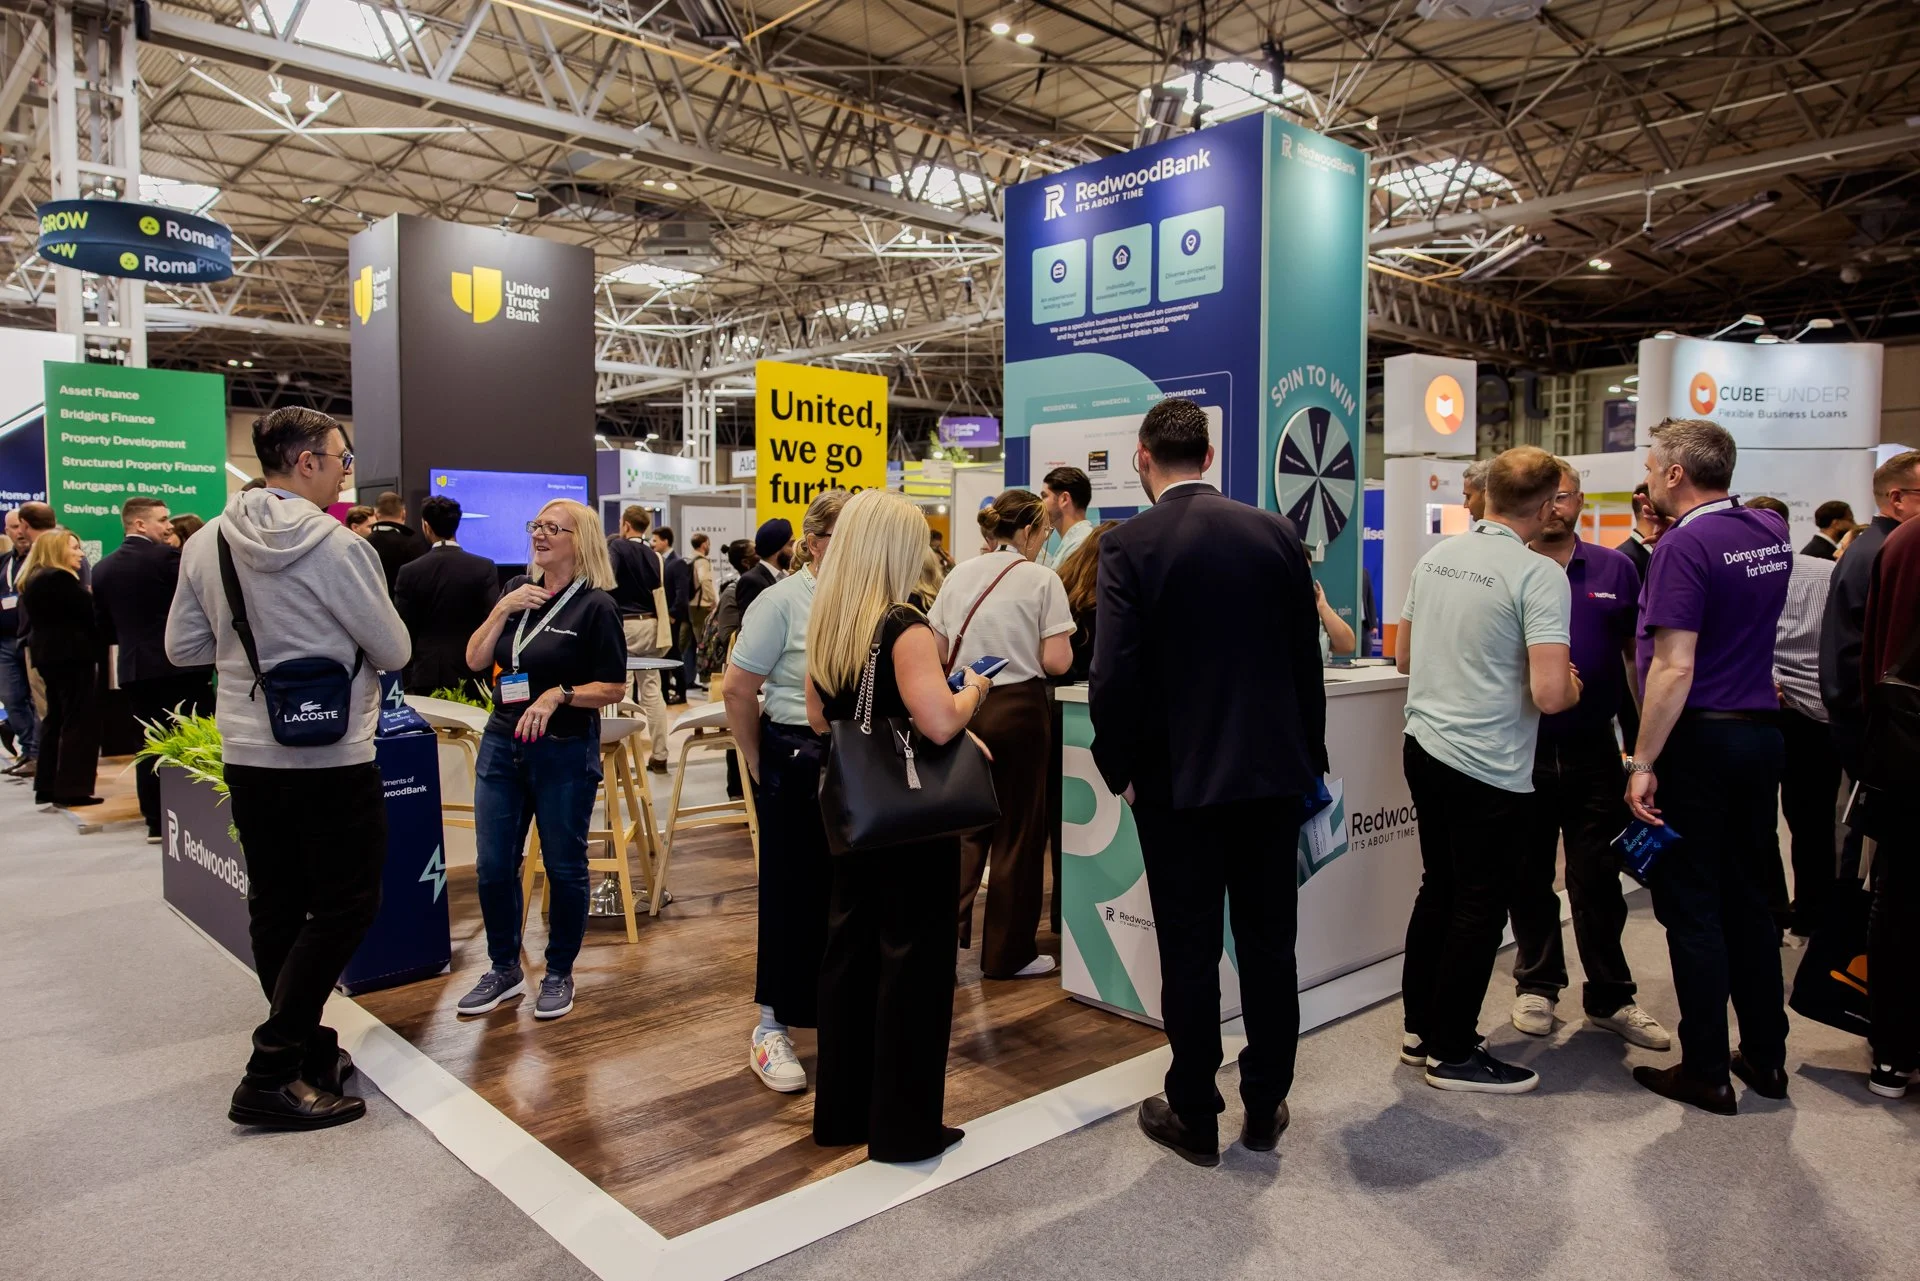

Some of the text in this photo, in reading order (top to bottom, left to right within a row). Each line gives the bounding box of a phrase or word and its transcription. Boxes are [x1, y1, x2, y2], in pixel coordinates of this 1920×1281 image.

[1297, 142, 1356, 176] RedwoodBank
[1075, 148, 1211, 202] RedwoodBank
[1075, 187, 1144, 213] IT'S ABOUT TIME
[41, 210, 88, 234] GROW
[505, 280, 550, 300] United
[505, 293, 540, 310] Trust
[506, 306, 540, 323] Bank
[1095, 317, 1118, 327] business
[1119, 314, 1132, 322] bank
[1133, 309, 1155, 320] focused
[1164, 301, 1199, 314] commercial
[1067, 331, 1077, 340] buy
[1092, 325, 1121, 337] mortgages
[1130, 317, 1164, 330] experienced
[1164, 312, 1190, 324] property
[1134, 328, 1152, 337] British
[59, 385, 140, 400] Asset Finance
[1092, 397, 1131, 408] COMMERCIAL
[1146, 387, 1207, 401] SEMI-COMMERCIAL
[1271, 365, 1356, 417] SPIN TO WIN
[1719, 386, 1850, 402] CUBEFUNDER
[60, 409, 155, 425] Bridging Finance
[770, 388, 882, 437] United,
[1718, 408, 1848, 419] Flexible Business Loans
[61, 433, 186, 449] Property Development
[62, 457, 217, 473] Structured Property Finance
[769, 438, 863, 473] we go
[33, 491, 45, 501] of
[63, 480, 197, 495] Mortgages & Buy-To-Let
[64, 504, 109, 517] Savings
[111, 505, 120, 515] &
[1723, 550, 1753, 565] Doing
[1751, 549, 1757, 558] a
[1756, 543, 1781, 560] great
[1433, 565, 1469, 579] ABOUT
[1468, 572, 1496, 588] TIME
[1746, 560, 1788, 578] for brokers
[284, 710, 338, 723] LACOSTE
[1351, 827, 1415, 852] IT'S ABOUT TIME
